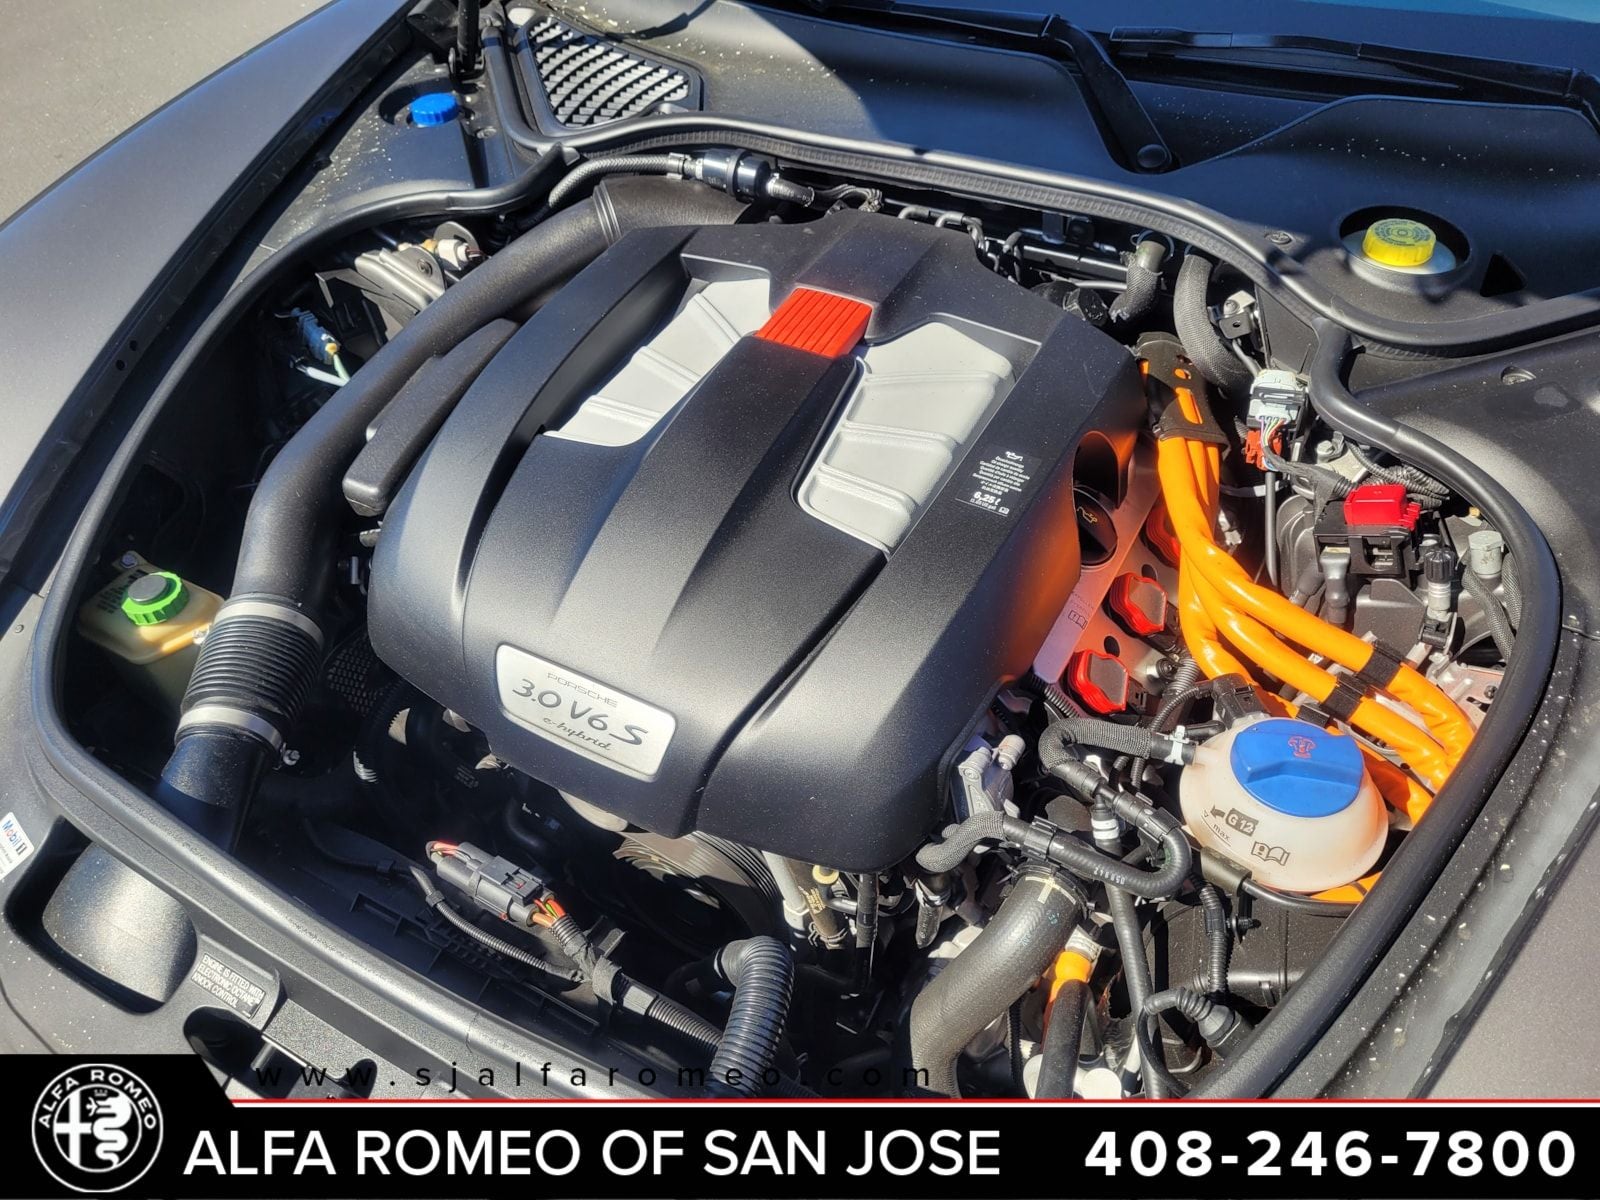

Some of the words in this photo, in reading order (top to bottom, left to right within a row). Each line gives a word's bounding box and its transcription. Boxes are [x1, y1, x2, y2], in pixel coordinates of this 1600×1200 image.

[547, 672, 618, 709] PORSCHE
[512, 678, 562, 709] 3.0
[608, 724, 649, 746] S
[542, 716, 612, 751] e-hybrid
[2, 819, 23, 848] Mobil
[1213, 823, 1231, 841] max
[191, 971, 214, 991] KNOCK
[211, 984, 240, 1008] CONTROL
[197, 963, 233, 991] ELECTRONIC
[231, 984, 257, 1006] OCTANE
[202, 954, 225, 973] ENGINE
[223, 966, 231, 978] IS
[229, 970, 250, 990] FITTED
[248, 982, 266, 999] WITH
